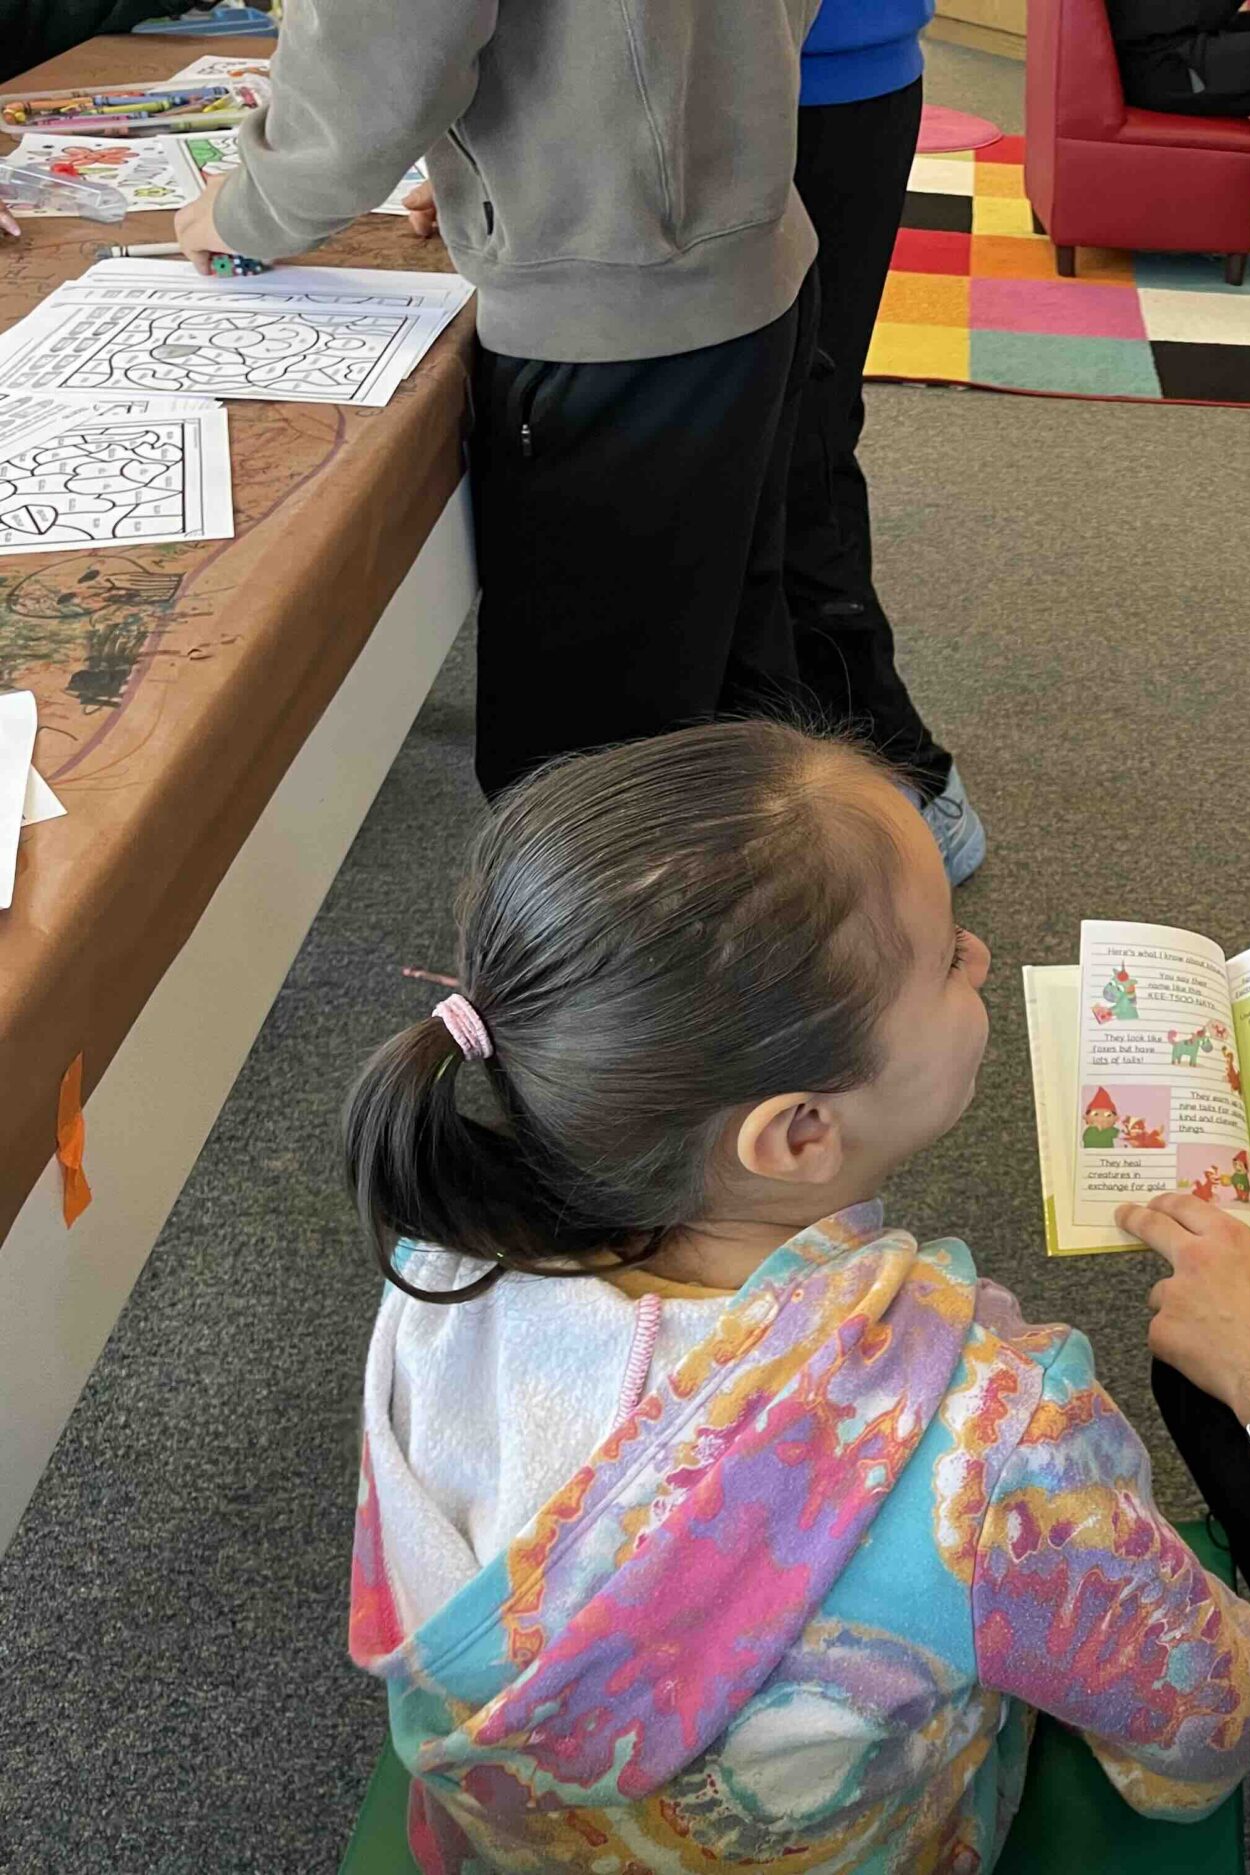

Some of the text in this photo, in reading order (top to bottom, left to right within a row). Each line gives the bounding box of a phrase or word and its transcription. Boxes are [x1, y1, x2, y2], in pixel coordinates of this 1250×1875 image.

[1108, 947, 1136, 957] Here's
[1164, 952, 1183, 963] know
[1160, 971, 1174, 981] You
[1104, 1033, 1163, 1043] They look like
[1092, 1045, 1155, 1053] foxes but have
[1092, 1057, 1109, 1065] lots
[1191, 1091, 1210, 1102] They
[1199, 1104, 1216, 1112] tails
[1218, 1105, 1229, 1114] for
[1216, 1117, 1237, 1127] clever
[1100, 1159, 1142, 1168] They heal
[1088, 1171, 1130, 1179] creatures
[1088, 1182, 1129, 1192] exchange
[1130, 1182, 1144, 1192] for
